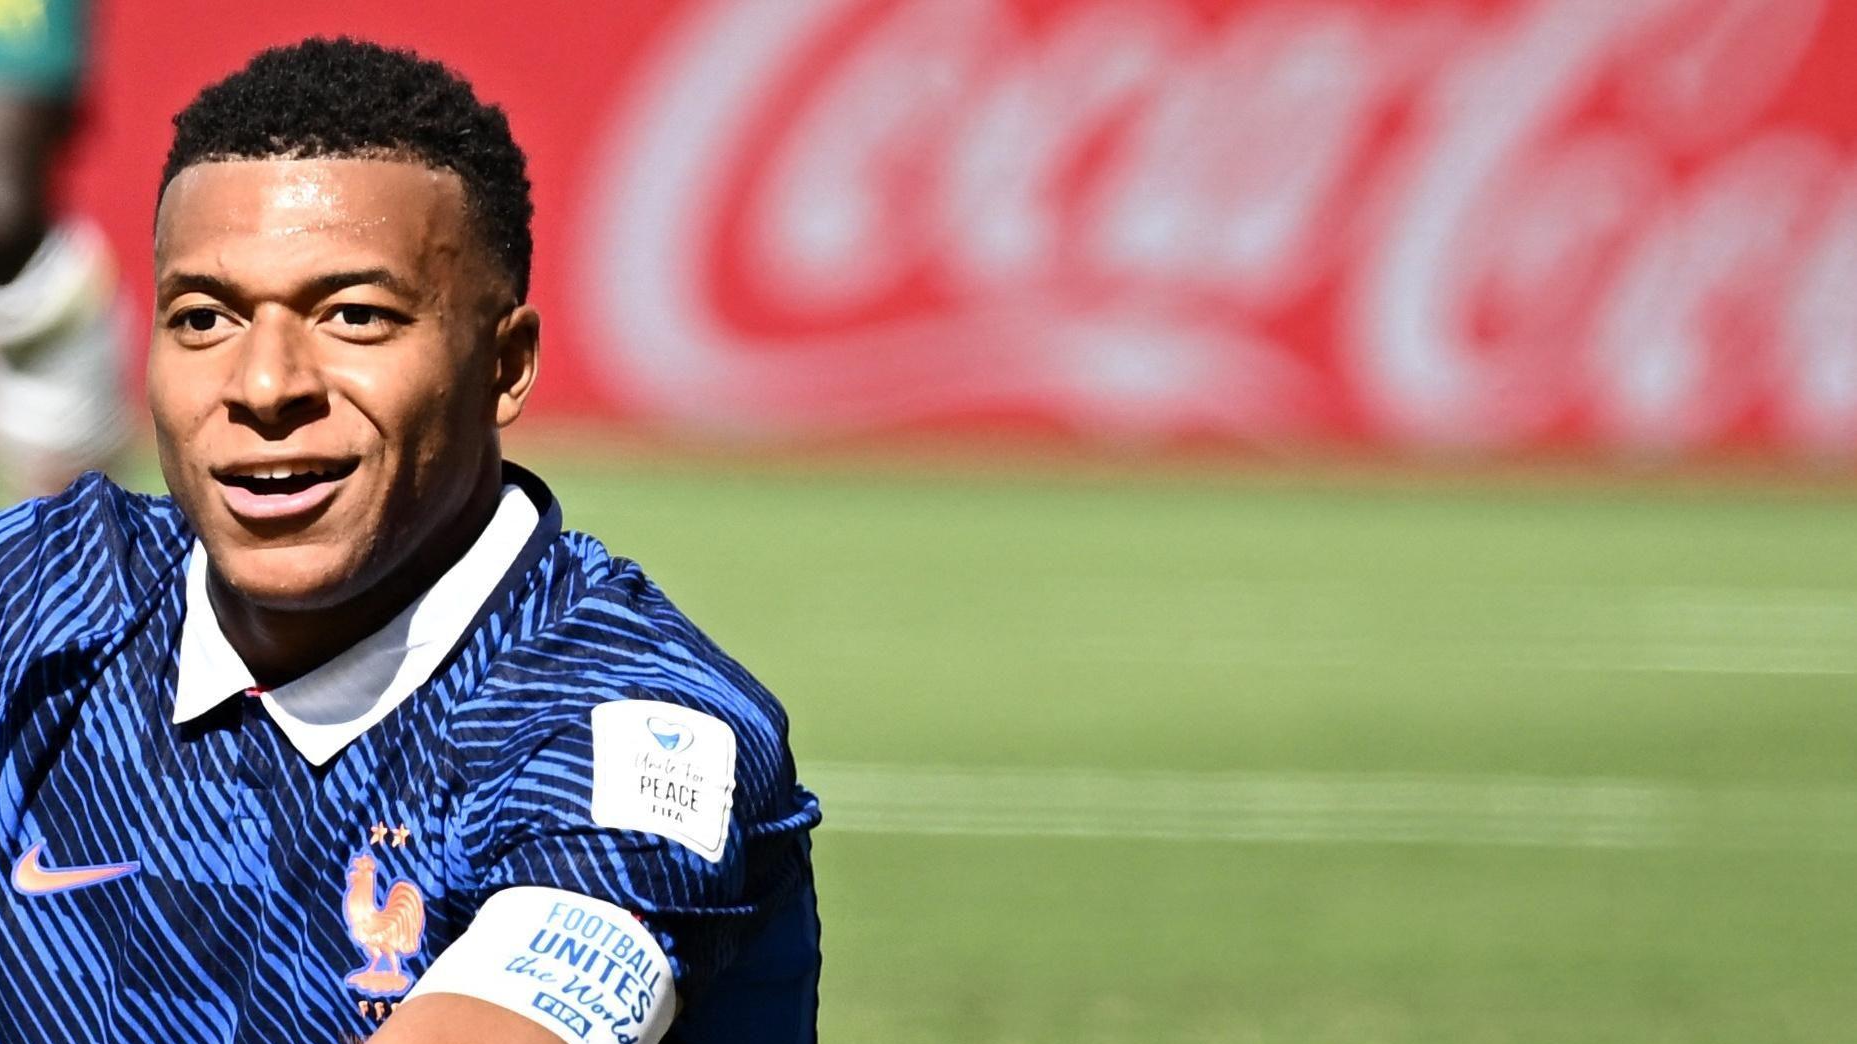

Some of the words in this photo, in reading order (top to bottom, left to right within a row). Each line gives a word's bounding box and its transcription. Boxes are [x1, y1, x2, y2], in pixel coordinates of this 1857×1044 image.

[640, 775, 700, 813] PEACE
[505, 955, 557, 983] the
[547, 902, 661, 999] FOOTBALL
[529, 929, 652, 1025] UNITES
[534, 992, 591, 1039] FIFA
